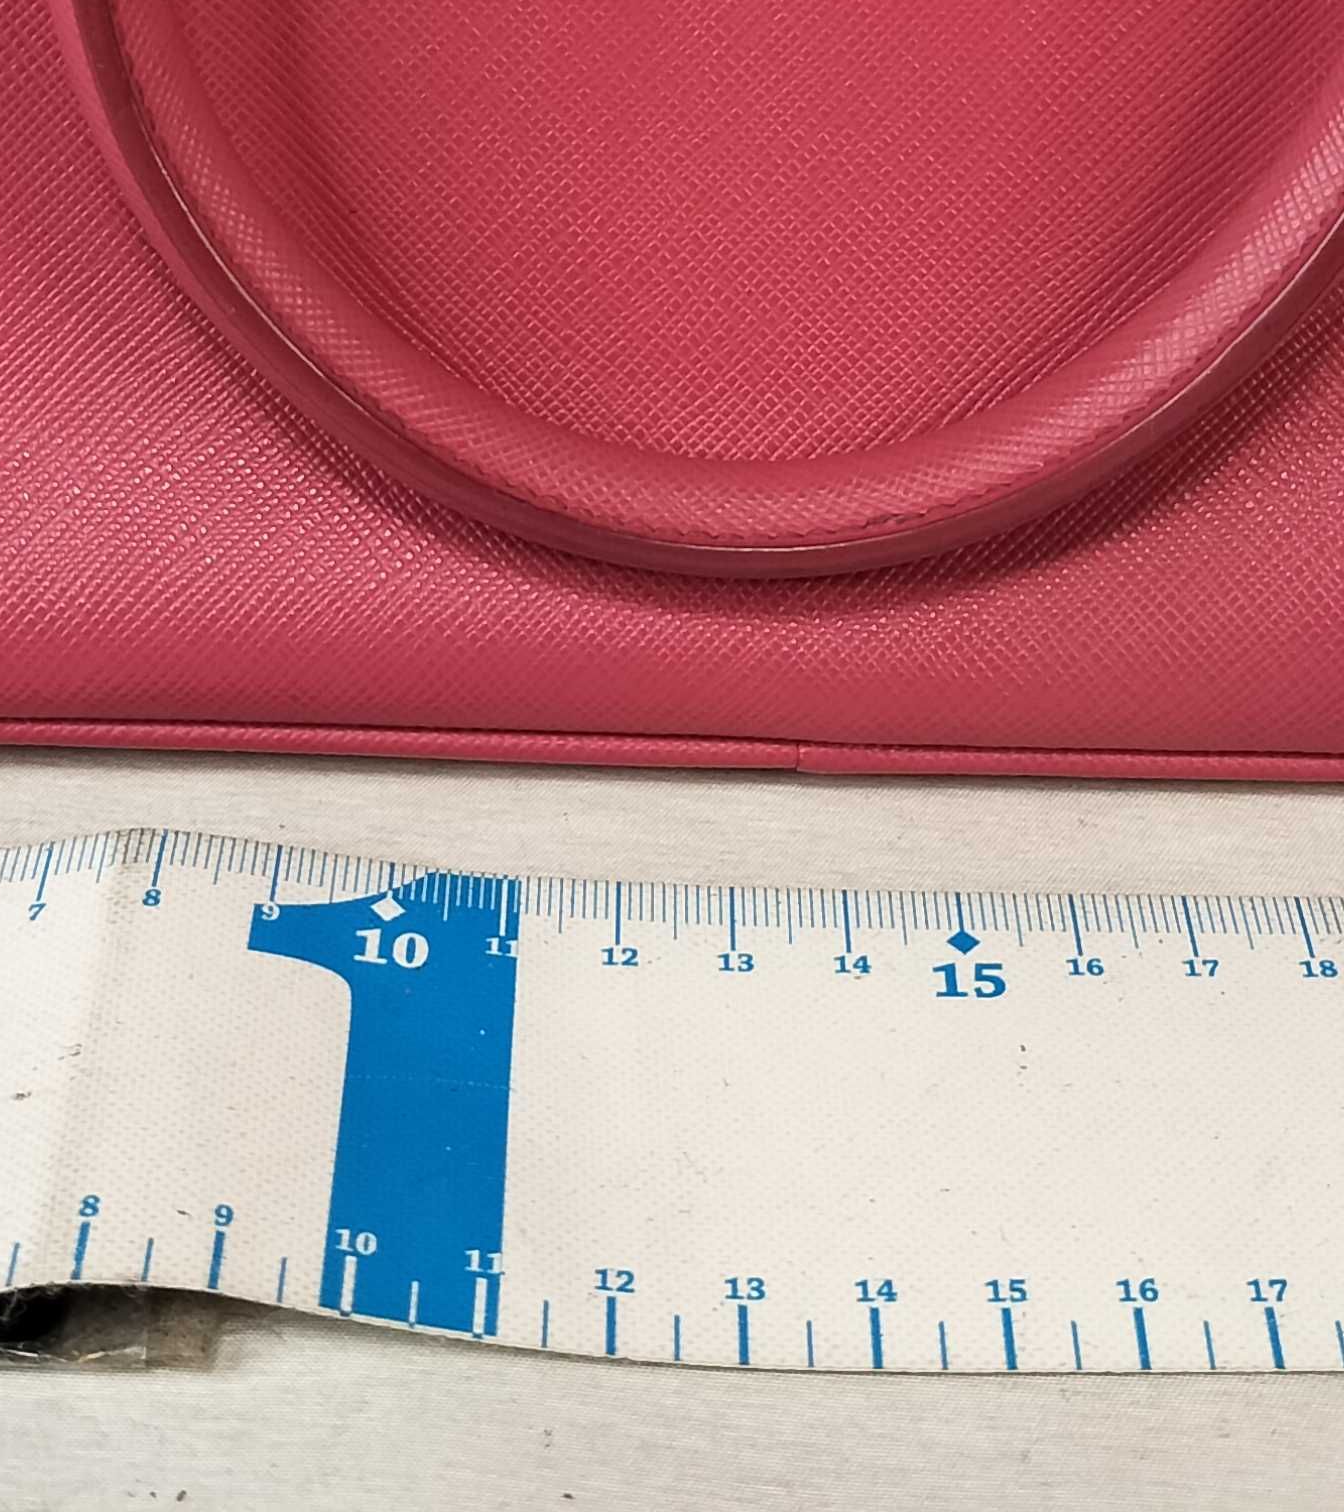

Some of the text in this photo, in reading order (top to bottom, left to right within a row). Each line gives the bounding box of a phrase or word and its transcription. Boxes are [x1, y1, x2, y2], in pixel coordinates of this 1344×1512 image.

[27, 903, 46, 921] 7
[141, 889, 161, 907] 8
[261, 901, 280, 922] 9
[353, 928, 430, 969] 10
[484, 936, 519, 957] 11
[600, 947, 640, 968] 12
[717, 952, 755, 973] 13
[834, 953, 871, 974] 14
[932, 962, 1007, 999] 15
[1066, 957, 1105, 977] 16
[1183, 958, 1220, 978] 17
[1300, 959, 1338, 979] 18
[247, 870, 521, 1337] 1
[78, 1194, 102, 1218] 8
[214, 1204, 235, 1227] 9
[334, 1228, 378, 1256] 10
[464, 1248, 505, 1275] 11
[593, 1267, 636, 1294] 12
[723, 1277, 767, 1301] 13
[855, 1278, 899, 1303] 14
[984, 1278, 1028, 1303] 15
[1116, 1278, 1160, 1303] 16
[1246, 1278, 1288, 1303] 17
